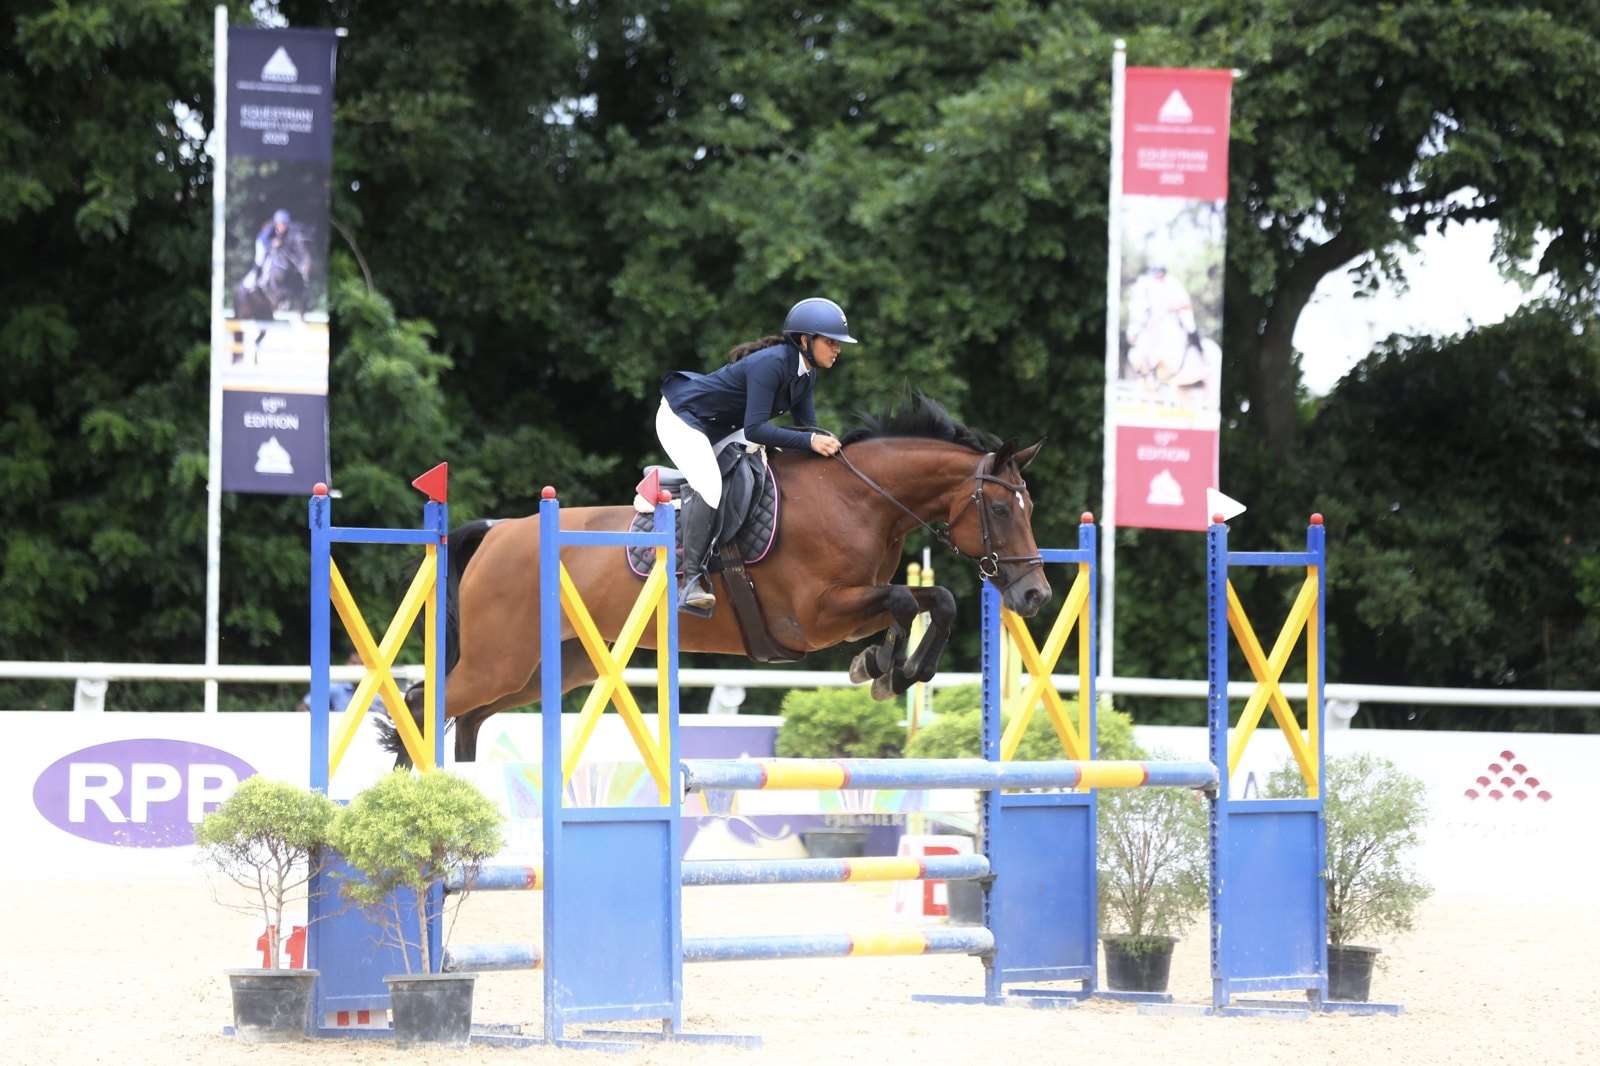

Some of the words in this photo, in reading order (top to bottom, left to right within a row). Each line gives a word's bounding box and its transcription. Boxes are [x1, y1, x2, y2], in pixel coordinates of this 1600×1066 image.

[240, 105, 313, 121] EQUESTRIAN
[243, 411, 299, 430] EDITION
[1137, 446, 1190, 462] EDITION
[68, 762, 239, 823] RPP
[1444, 821, 1567, 841] STONE
